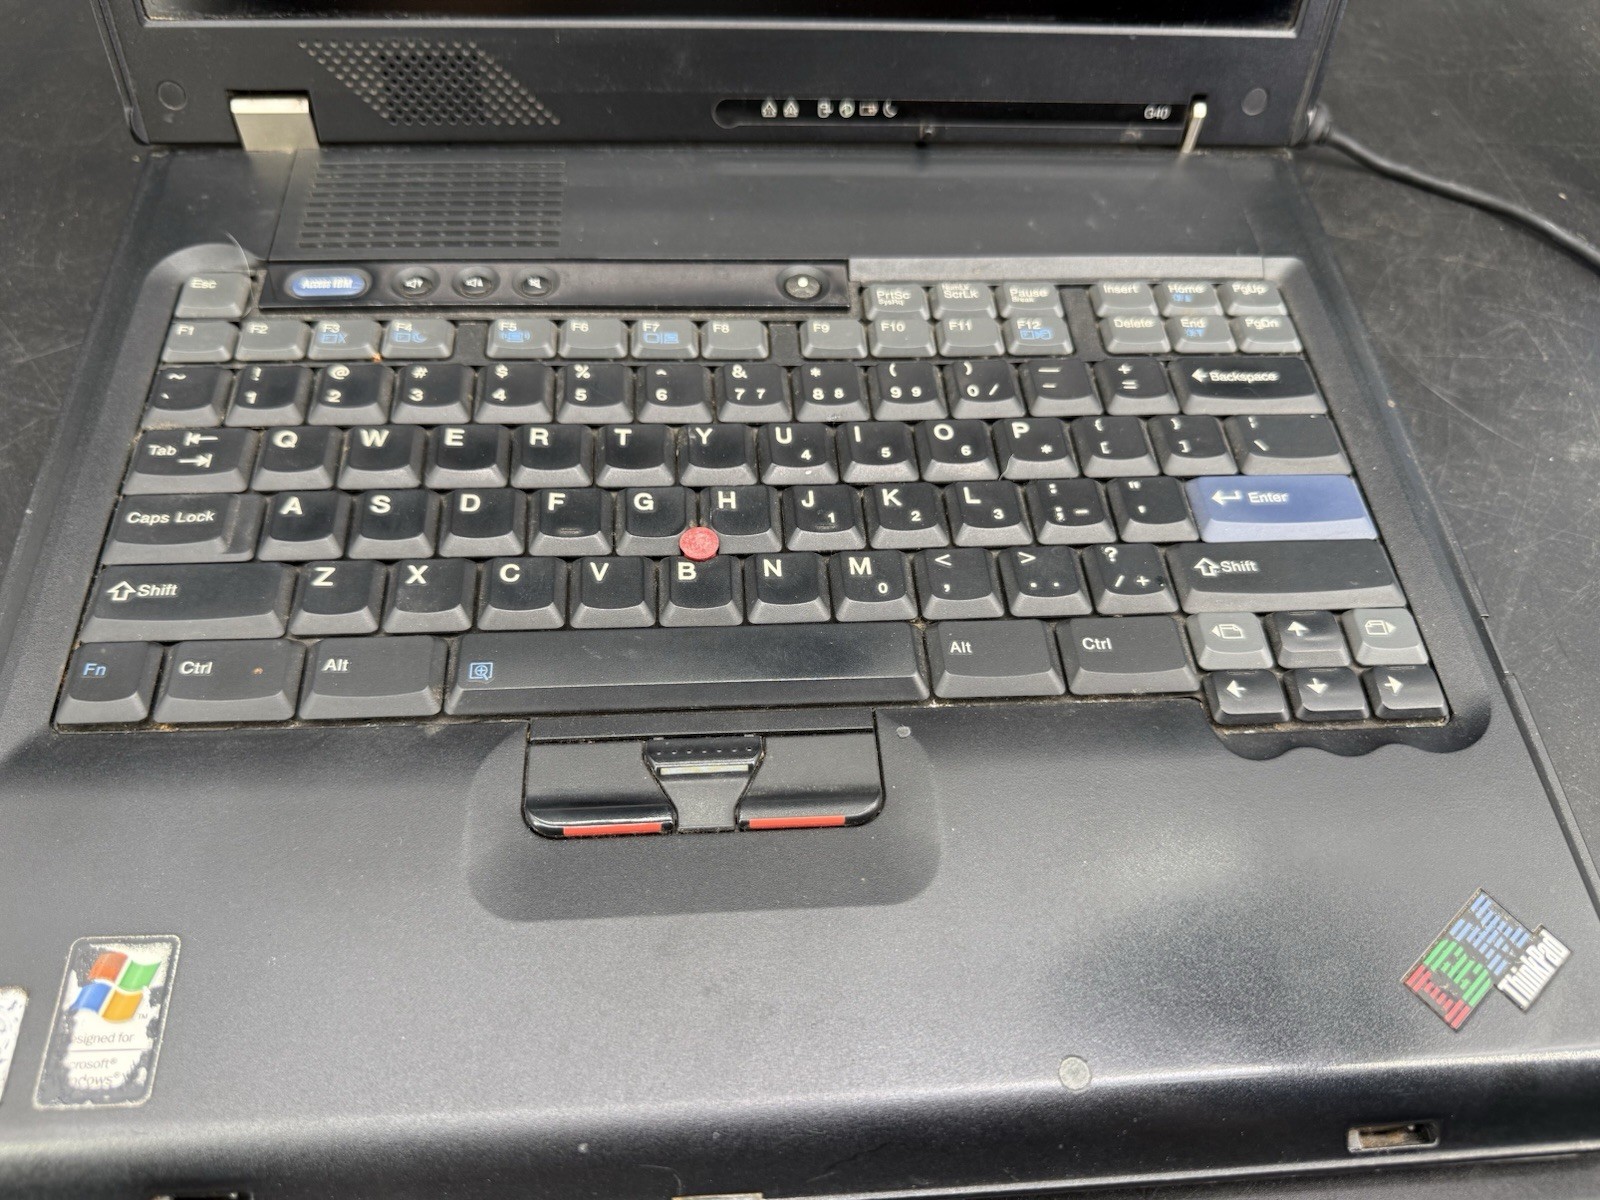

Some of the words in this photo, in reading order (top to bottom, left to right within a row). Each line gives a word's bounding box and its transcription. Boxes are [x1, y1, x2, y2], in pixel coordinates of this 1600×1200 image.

[1144, 104, 1170, 120] G40
[190, 278, 217, 290] Esc
[1103, 284, 1141, 294] Insert
[1168, 283, 1206, 295] Home
[1232, 283, 1269, 297] PgUp
[876, 289, 911, 300] PrtSc
[943, 290, 979, 300] ScrLk
[1009, 288, 1049, 298] Pause
[249, 324, 268, 335] F2
[322, 322, 341, 334] F3
[395, 321, 413, 333] F4
[500, 321, 518, 332] F5
[571, 321, 589, 333] F6
[643, 321, 660, 332] F7
[713, 323, 730, 334] F8
[813, 322, 830, 333] F9
[881, 321, 906, 332] F10
[949, 320, 973, 331] F11
[1016, 319, 1042, 330] F12
[1113, 317, 1156, 329] Delete
[1180, 317, 1208, 328] End
[1245, 317, 1281, 330] PgDn
[177, 324, 195, 336] F1
[251, 366, 262, 381] !
[329, 365, 350, 380] @
[411, 366, 428, 379] #
[495, 364, 509, 378] $
[574, 364, 591, 379] %
[731, 364, 748, 379] &
[889, 362, 898, 377] (
[964, 361, 973, 376] )
[1117, 363, 1133, 375] +
[1122, 379, 1138, 390] =
[1208, 371, 1279, 384] Backspace
[325, 389, 342, 402] 2
[409, 388, 424, 402] 3
[492, 388, 507, 402] 4
[574, 388, 588, 402] 5
[655, 388, 668, 401] 6
[734, 388, 746, 401] 7
[756, 387, 766, 399] 7
[812, 387, 825, 400] 8
[834, 387, 844, 399] 8
[890, 386, 902, 398] 9
[911, 386, 922, 398] 9
[966, 385, 980, 397] 0
[988, 383, 999, 396] /
[245, 391, 257, 404] 1
[529, 427, 549, 446] R
[695, 427, 713, 445] Y
[775, 427, 793, 444] U
[854, 426, 862, 442] I
[933, 424, 955, 441] O
[1011, 421, 1030, 438] P
[272, 430, 298, 448] Q
[360, 429, 389, 447] W
[444, 428, 465, 446] E
[614, 428, 632, 446] T
[148, 443, 177, 457] Tab
[961, 445, 972, 456] 6
[1100, 441, 1111, 454] [
[1180, 440, 1191, 453] ]
[1253, 439, 1269, 451] \
[801, 449, 812, 461] 4
[881, 447, 891, 458] 5
[459, 493, 481, 512] D
[548, 492, 566, 511] F
[634, 492, 655, 511] G
[717, 491, 737, 510] H
[801, 490, 815, 508] J
[882, 488, 903, 506] K
[963, 487, 981, 504] L
[1248, 492, 1288, 504] Enter
[279, 496, 303, 515] A
[369, 495, 391, 514] S
[126, 511, 170, 525] Caps
[175, 510, 217, 524] Lock
[827, 512, 836, 523] 1
[911, 511, 922, 522] 2
[993, 508, 1005, 520] 3
[935, 553, 952, 566] <
[1018, 552, 1036, 565] >
[1103, 547, 1118, 563] ?
[499, 563, 520, 583] C
[590, 562, 609, 581] V
[678, 562, 697, 580] B
[763, 559, 783, 578] N
[849, 558, 872, 575] M
[1220, 560, 1260, 573] Shift
[311, 567, 336, 587] Z
[406, 565, 429, 585] X
[1114, 574, 1125, 588] /
[1136, 575, 1150, 587] +
[137, 583, 178, 598] Shift
[949, 640, 972, 654] Alt
[1082, 637, 1112, 651] Ctrl
[82, 663, 107, 677] Fn
[178, 660, 212, 676] Ctrl
[322, 658, 348, 673] Alt
[1405, 893, 1531, 1030] IBM
[1497, 928, 1569, 1010] ThinkPad
[118, 1031, 135, 1043] for
